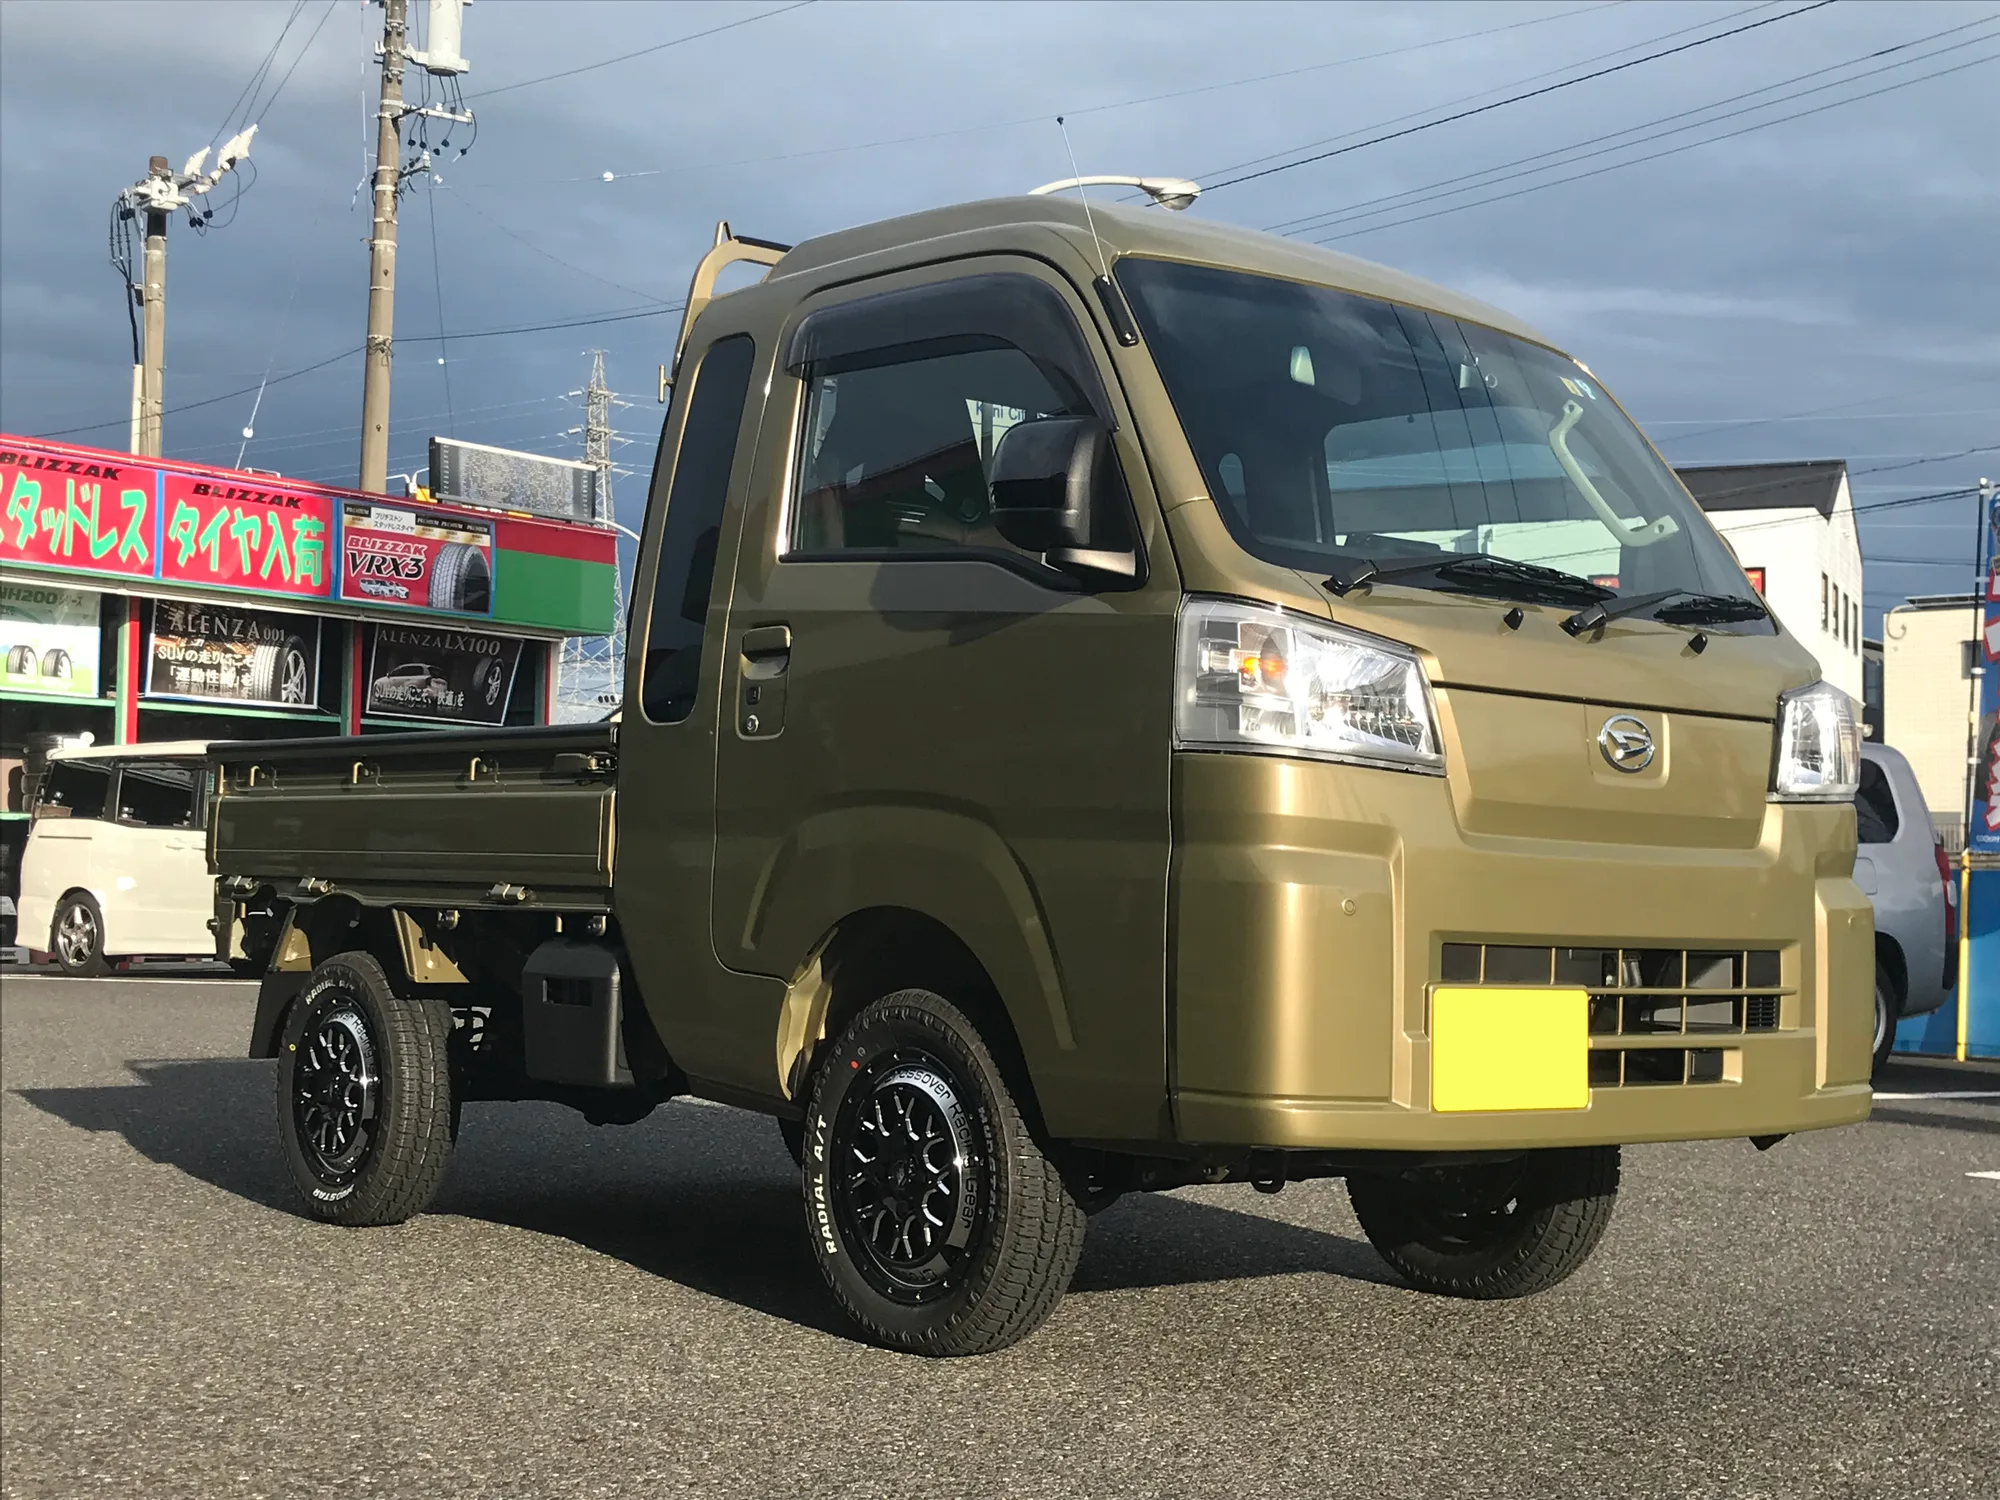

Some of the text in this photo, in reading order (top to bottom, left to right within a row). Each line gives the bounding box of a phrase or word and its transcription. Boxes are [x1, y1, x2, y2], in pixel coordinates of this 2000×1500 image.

[976, 401, 1004, 419] Kni
[0, 452, 122, 481] BLIZZAK
[192, 483, 304, 509] BLIZZAK
[0, 470, 149, 566] タッドレス
[168, 499, 325, 587] タイヤ入荷
[346, 535, 428, 556] BLIZZAK
[346, 550, 426, 580] VRX3
[170, 611, 285, 641] ALENZA 001
[379, 629, 501, 656] ALENZA LX100
[305, 979, 336, 1005] RADIAL
[813, 1114, 838, 1254] RADIAL A/T
[960, 1178, 978, 1229] Gear
